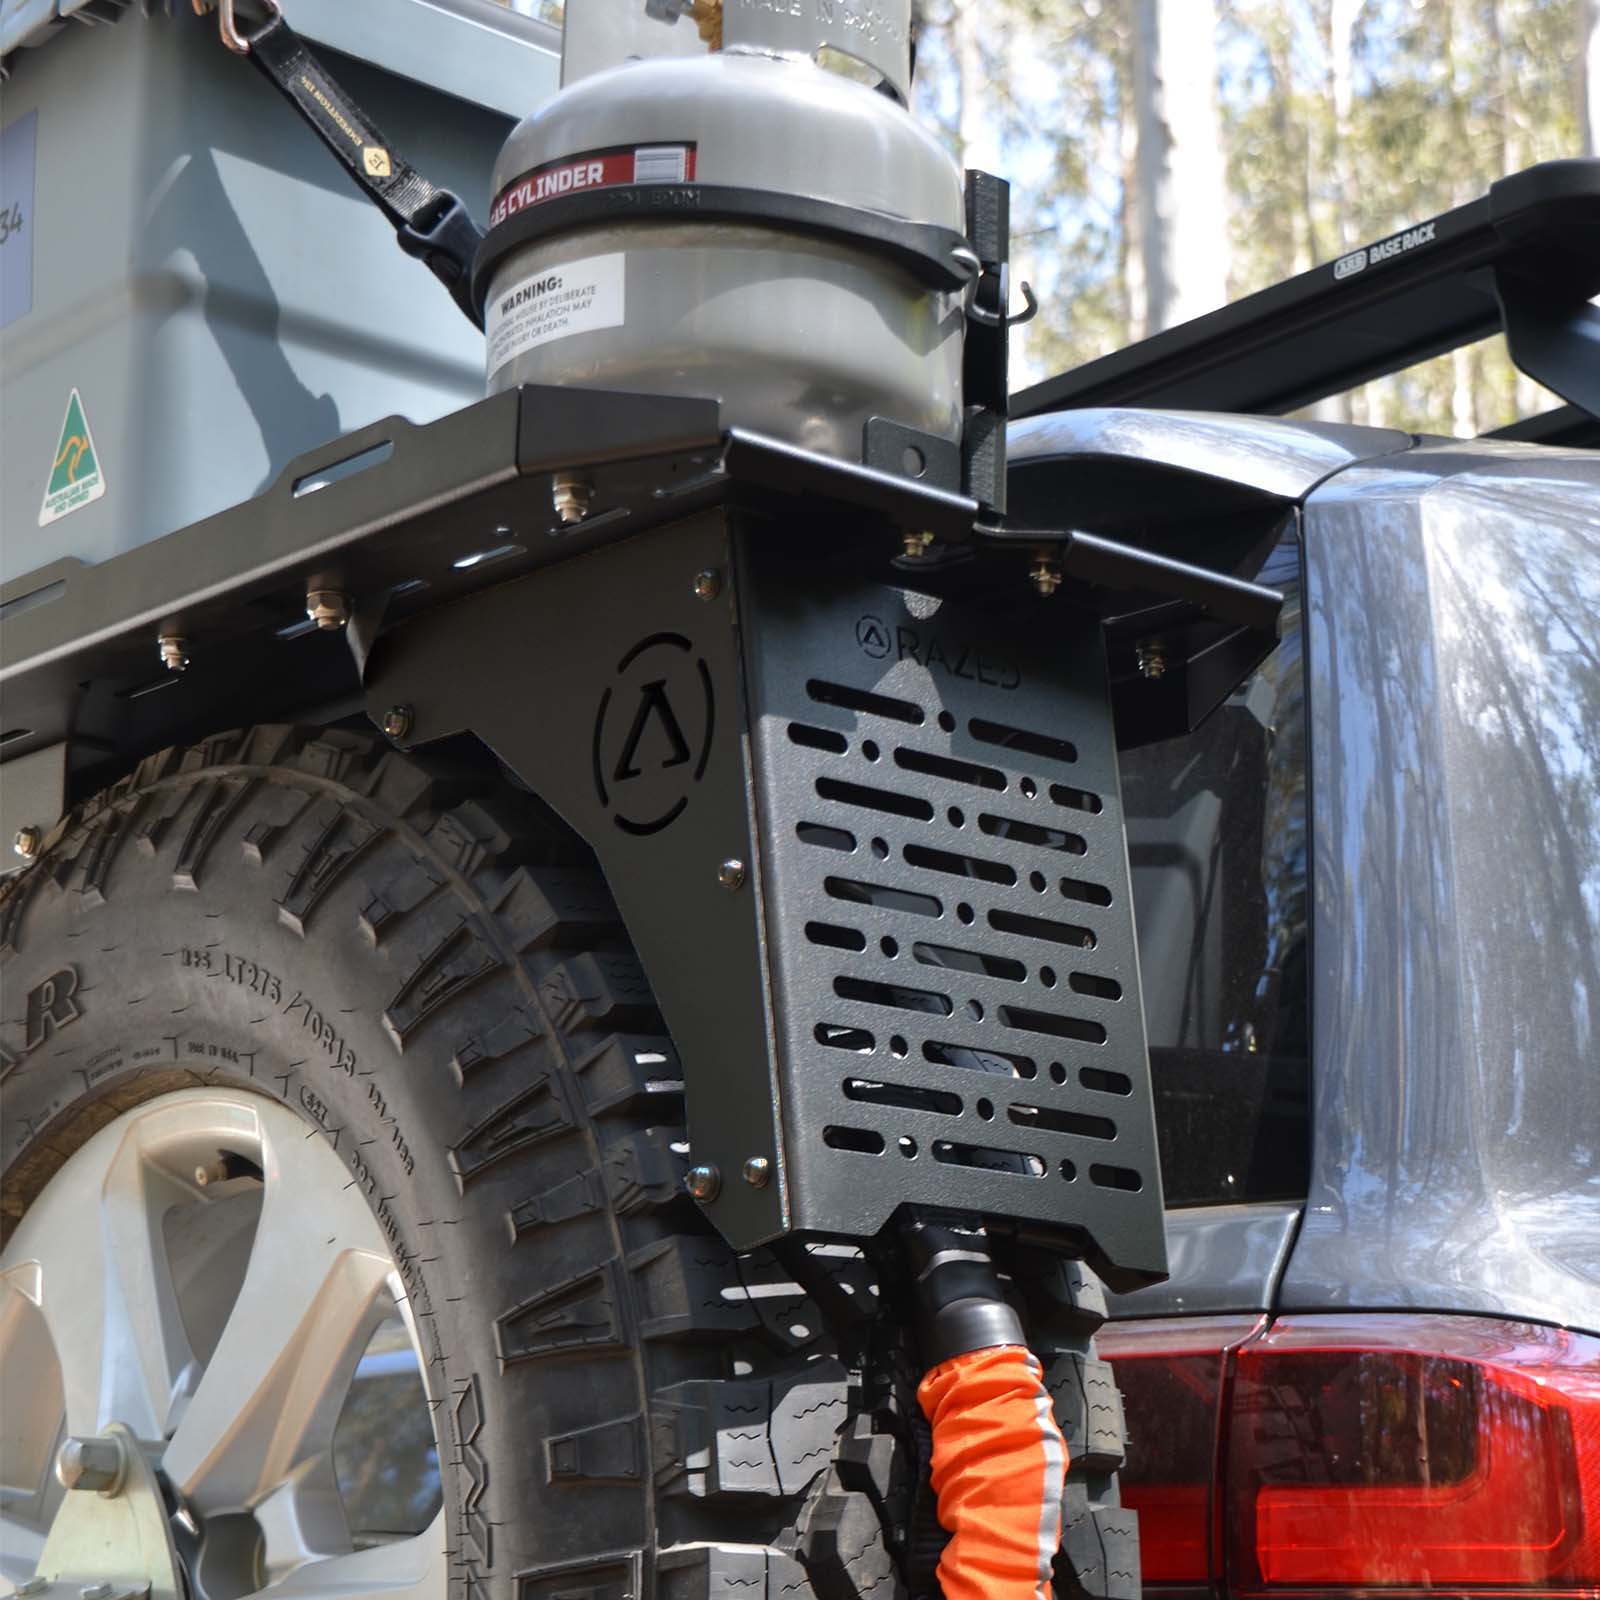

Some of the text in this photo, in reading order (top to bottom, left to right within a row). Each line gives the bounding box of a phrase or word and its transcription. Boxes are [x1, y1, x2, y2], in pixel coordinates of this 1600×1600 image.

[508, 161, 604, 214] CYLINDER
[1369, 236, 1402, 264] BASE
[1402, 222, 1436, 251] RACK
[501, 276, 563, 317] WARNING:
